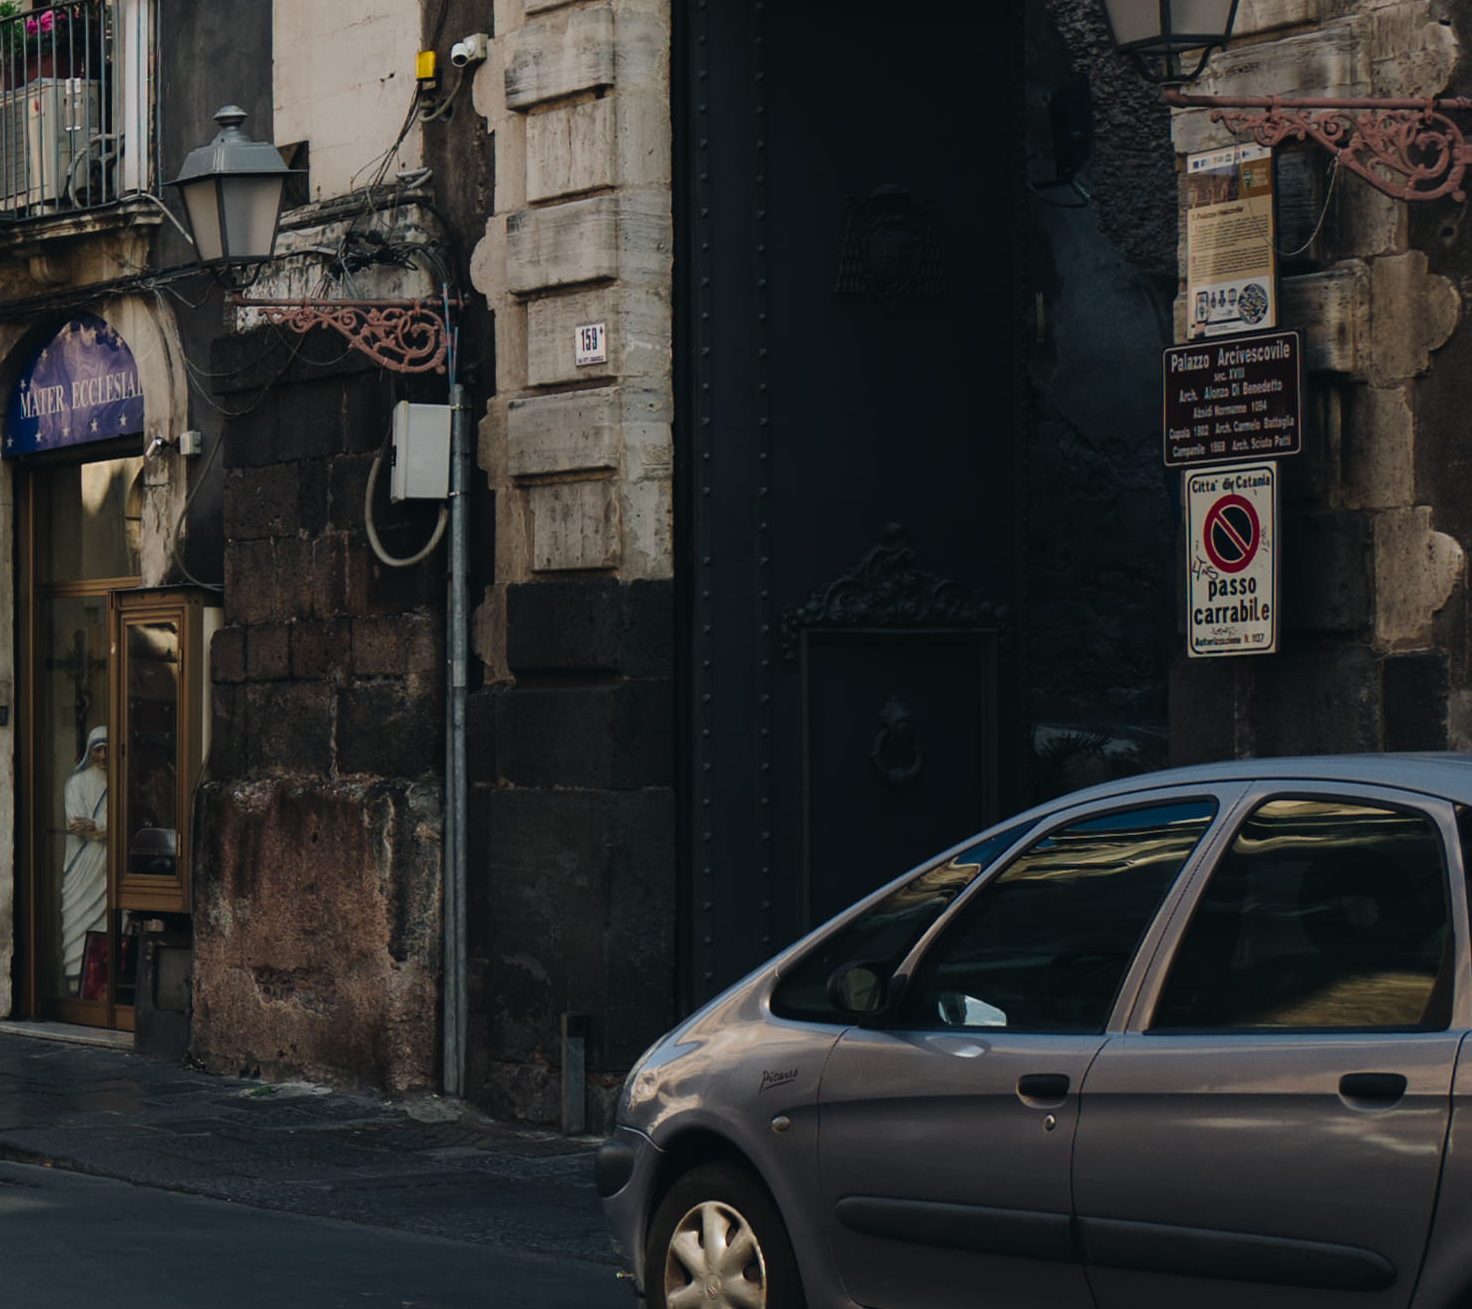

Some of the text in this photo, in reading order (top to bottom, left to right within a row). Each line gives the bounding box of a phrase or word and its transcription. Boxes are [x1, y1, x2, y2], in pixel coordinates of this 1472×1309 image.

[580, 327, 598, 351] 159
[1171, 339, 1292, 373] Palazzo Arcivescovile
[20, 385, 64, 420] MATER
[1179, 388, 1199, 403] Arch.
[1242, 378, 1284, 396] Benedetto
[1236, 474, 1271, 490] Catania
[1209, 576, 1257, 602] passo
[1194, 597, 1270, 626] carrabile
